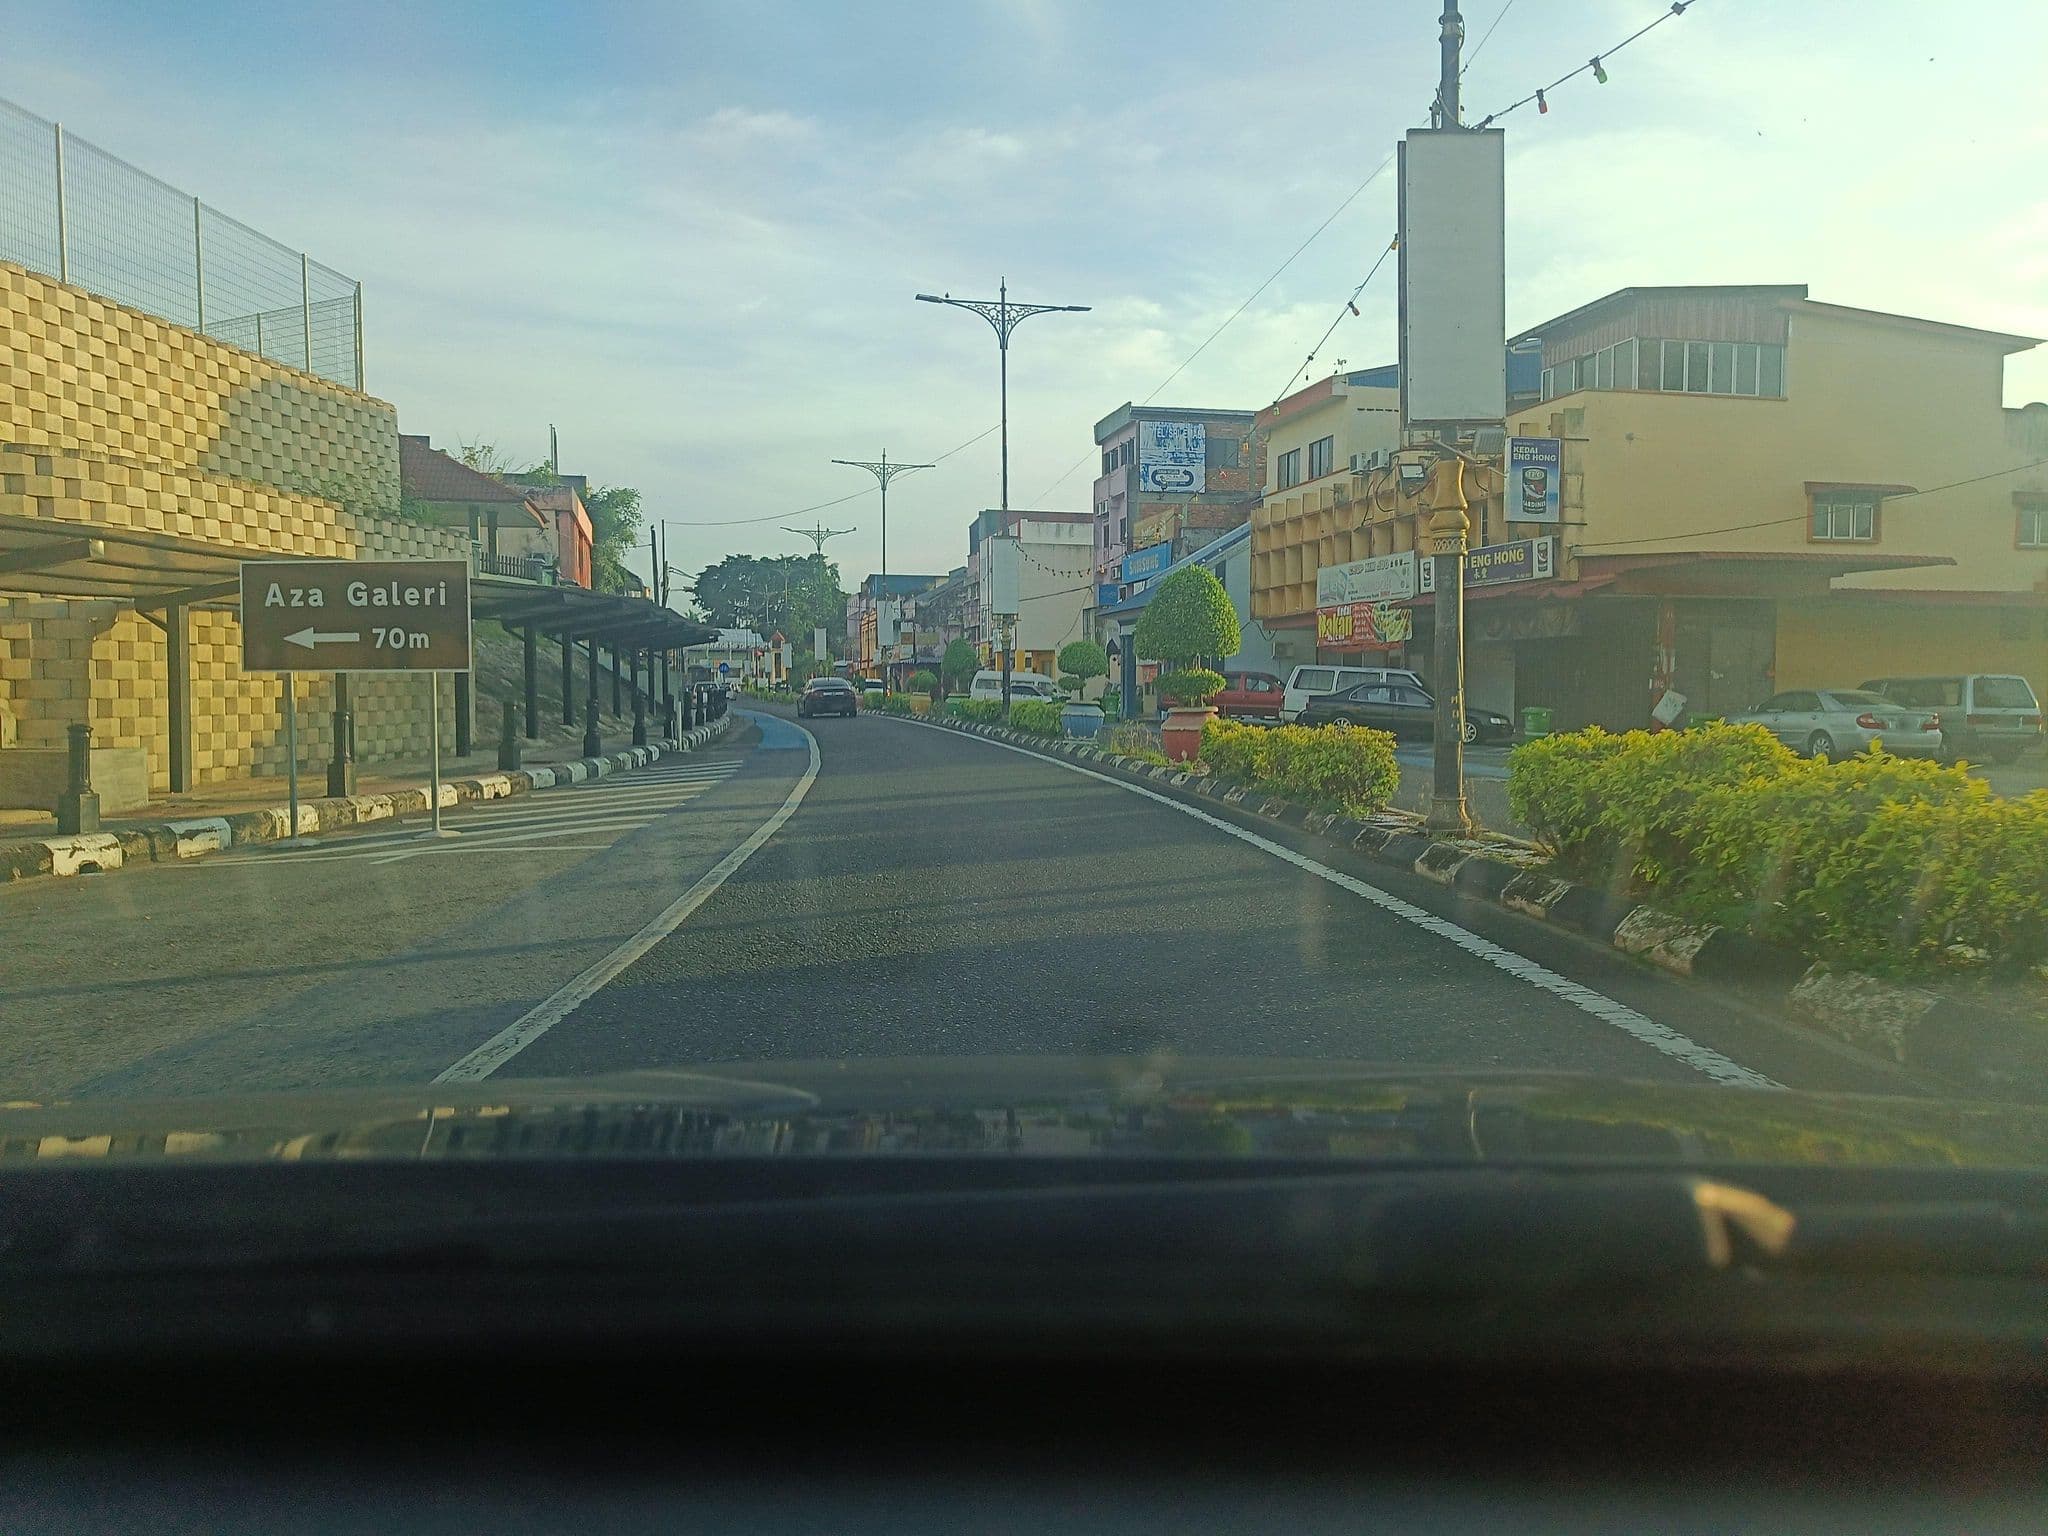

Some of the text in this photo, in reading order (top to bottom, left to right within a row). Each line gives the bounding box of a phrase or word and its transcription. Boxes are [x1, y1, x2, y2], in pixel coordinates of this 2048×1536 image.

[1513, 446, 1538, 454] KEDAI
[1513, 453, 1557, 462] ENG HONG
[1471, 553, 1491, 569] ENG
[1493, 548, 1525, 565] HONG
[264, 580, 447, 608] Aza Galeri
[371, 627, 430, 650] 70m
